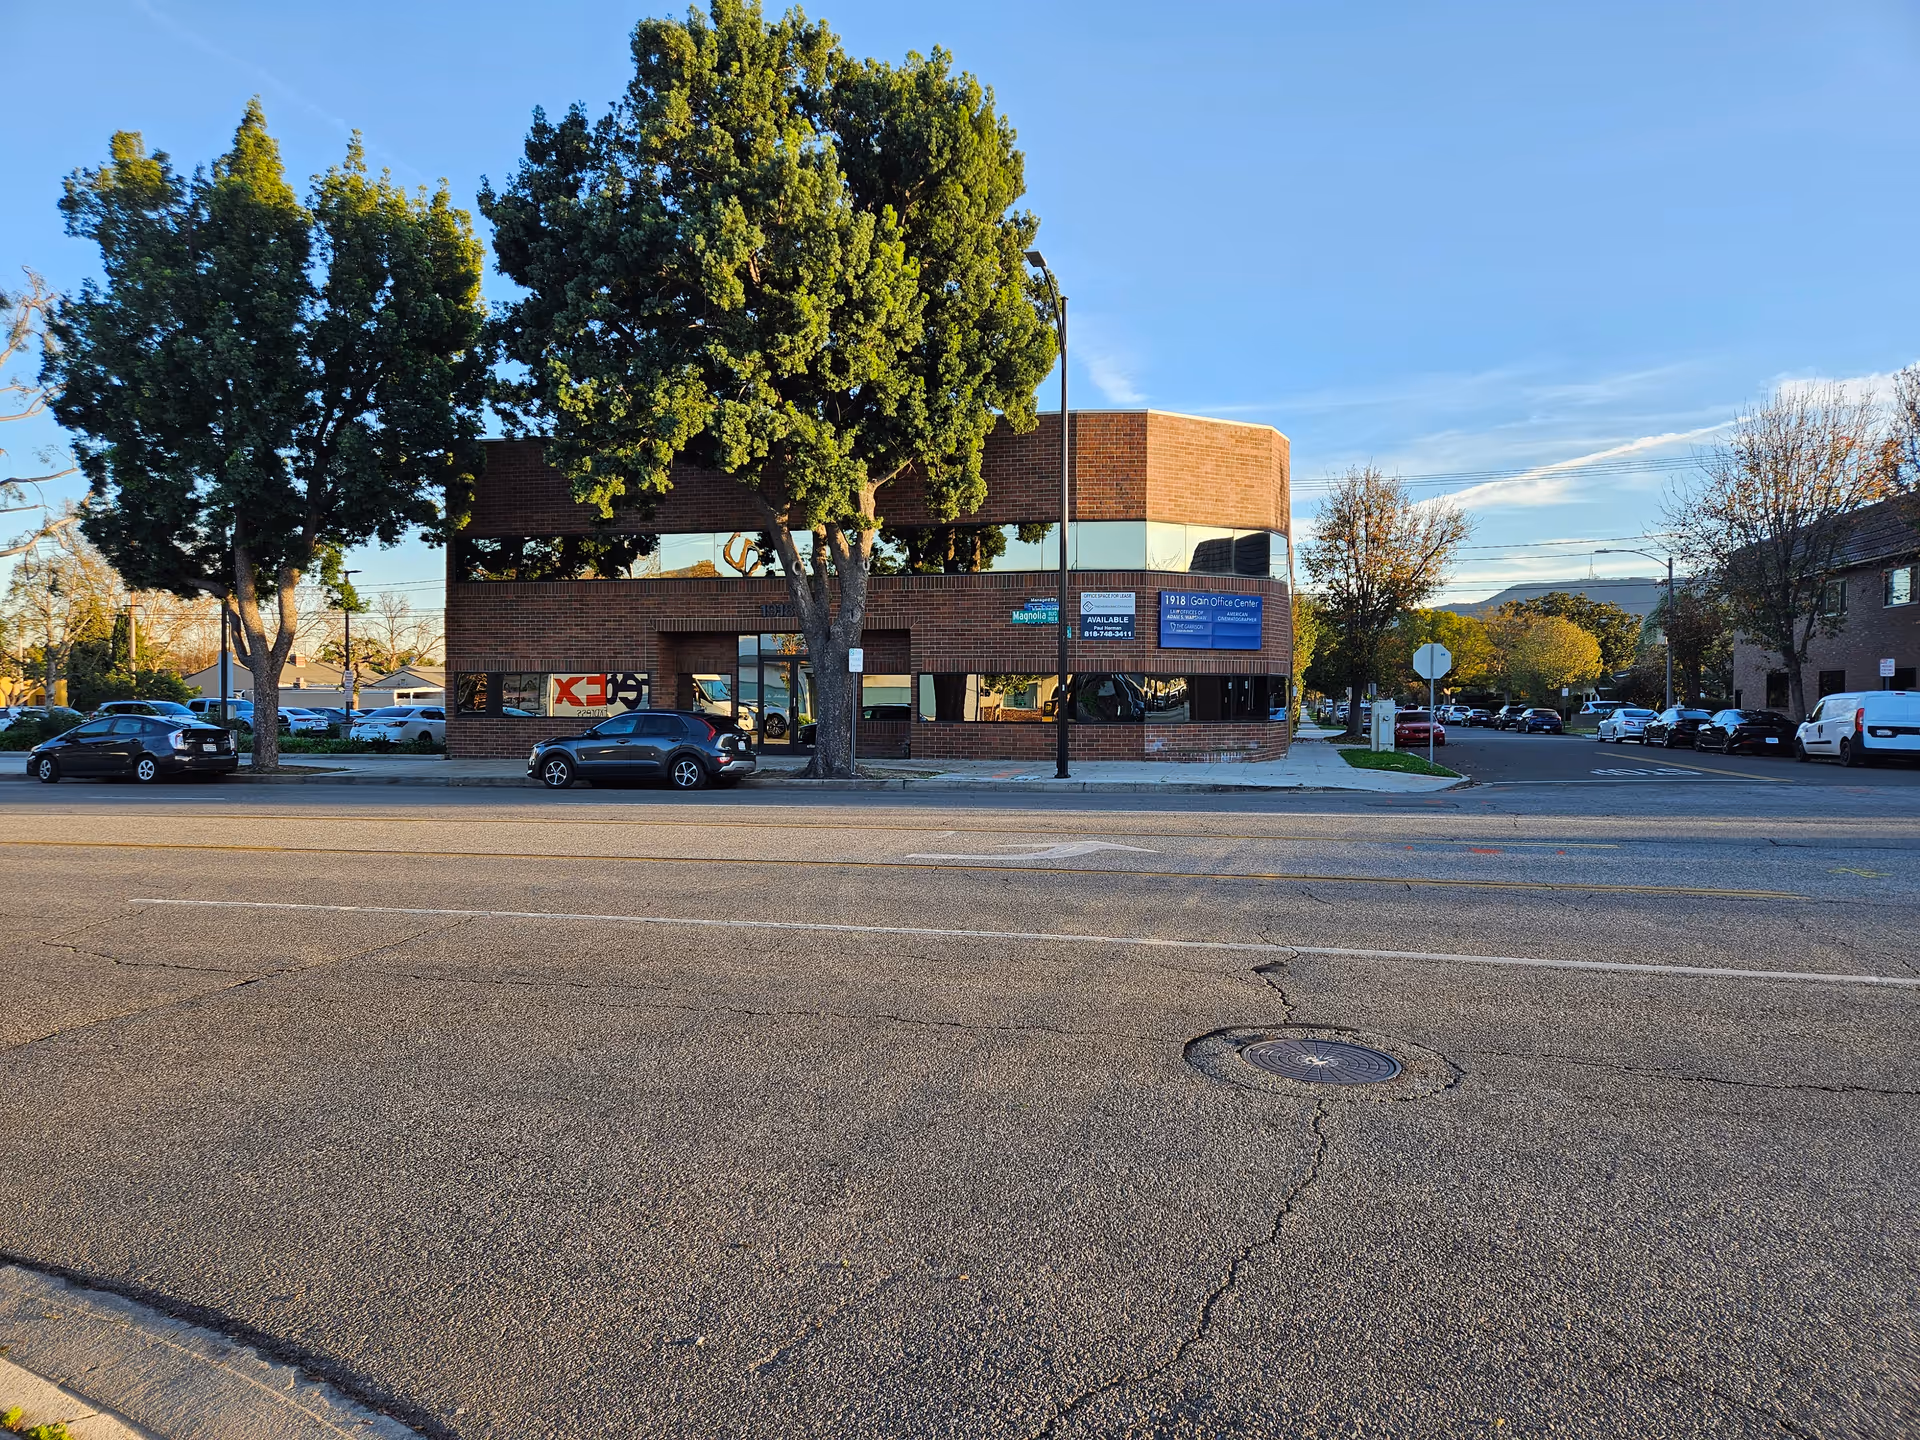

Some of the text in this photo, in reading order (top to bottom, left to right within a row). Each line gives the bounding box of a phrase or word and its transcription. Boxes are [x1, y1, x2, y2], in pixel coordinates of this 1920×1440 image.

[1165, 595, 1258, 608] 1918 Gain Office Center
[761, 604, 794, 616] 1918
[1012, 611, 1046, 622] Magnolia
